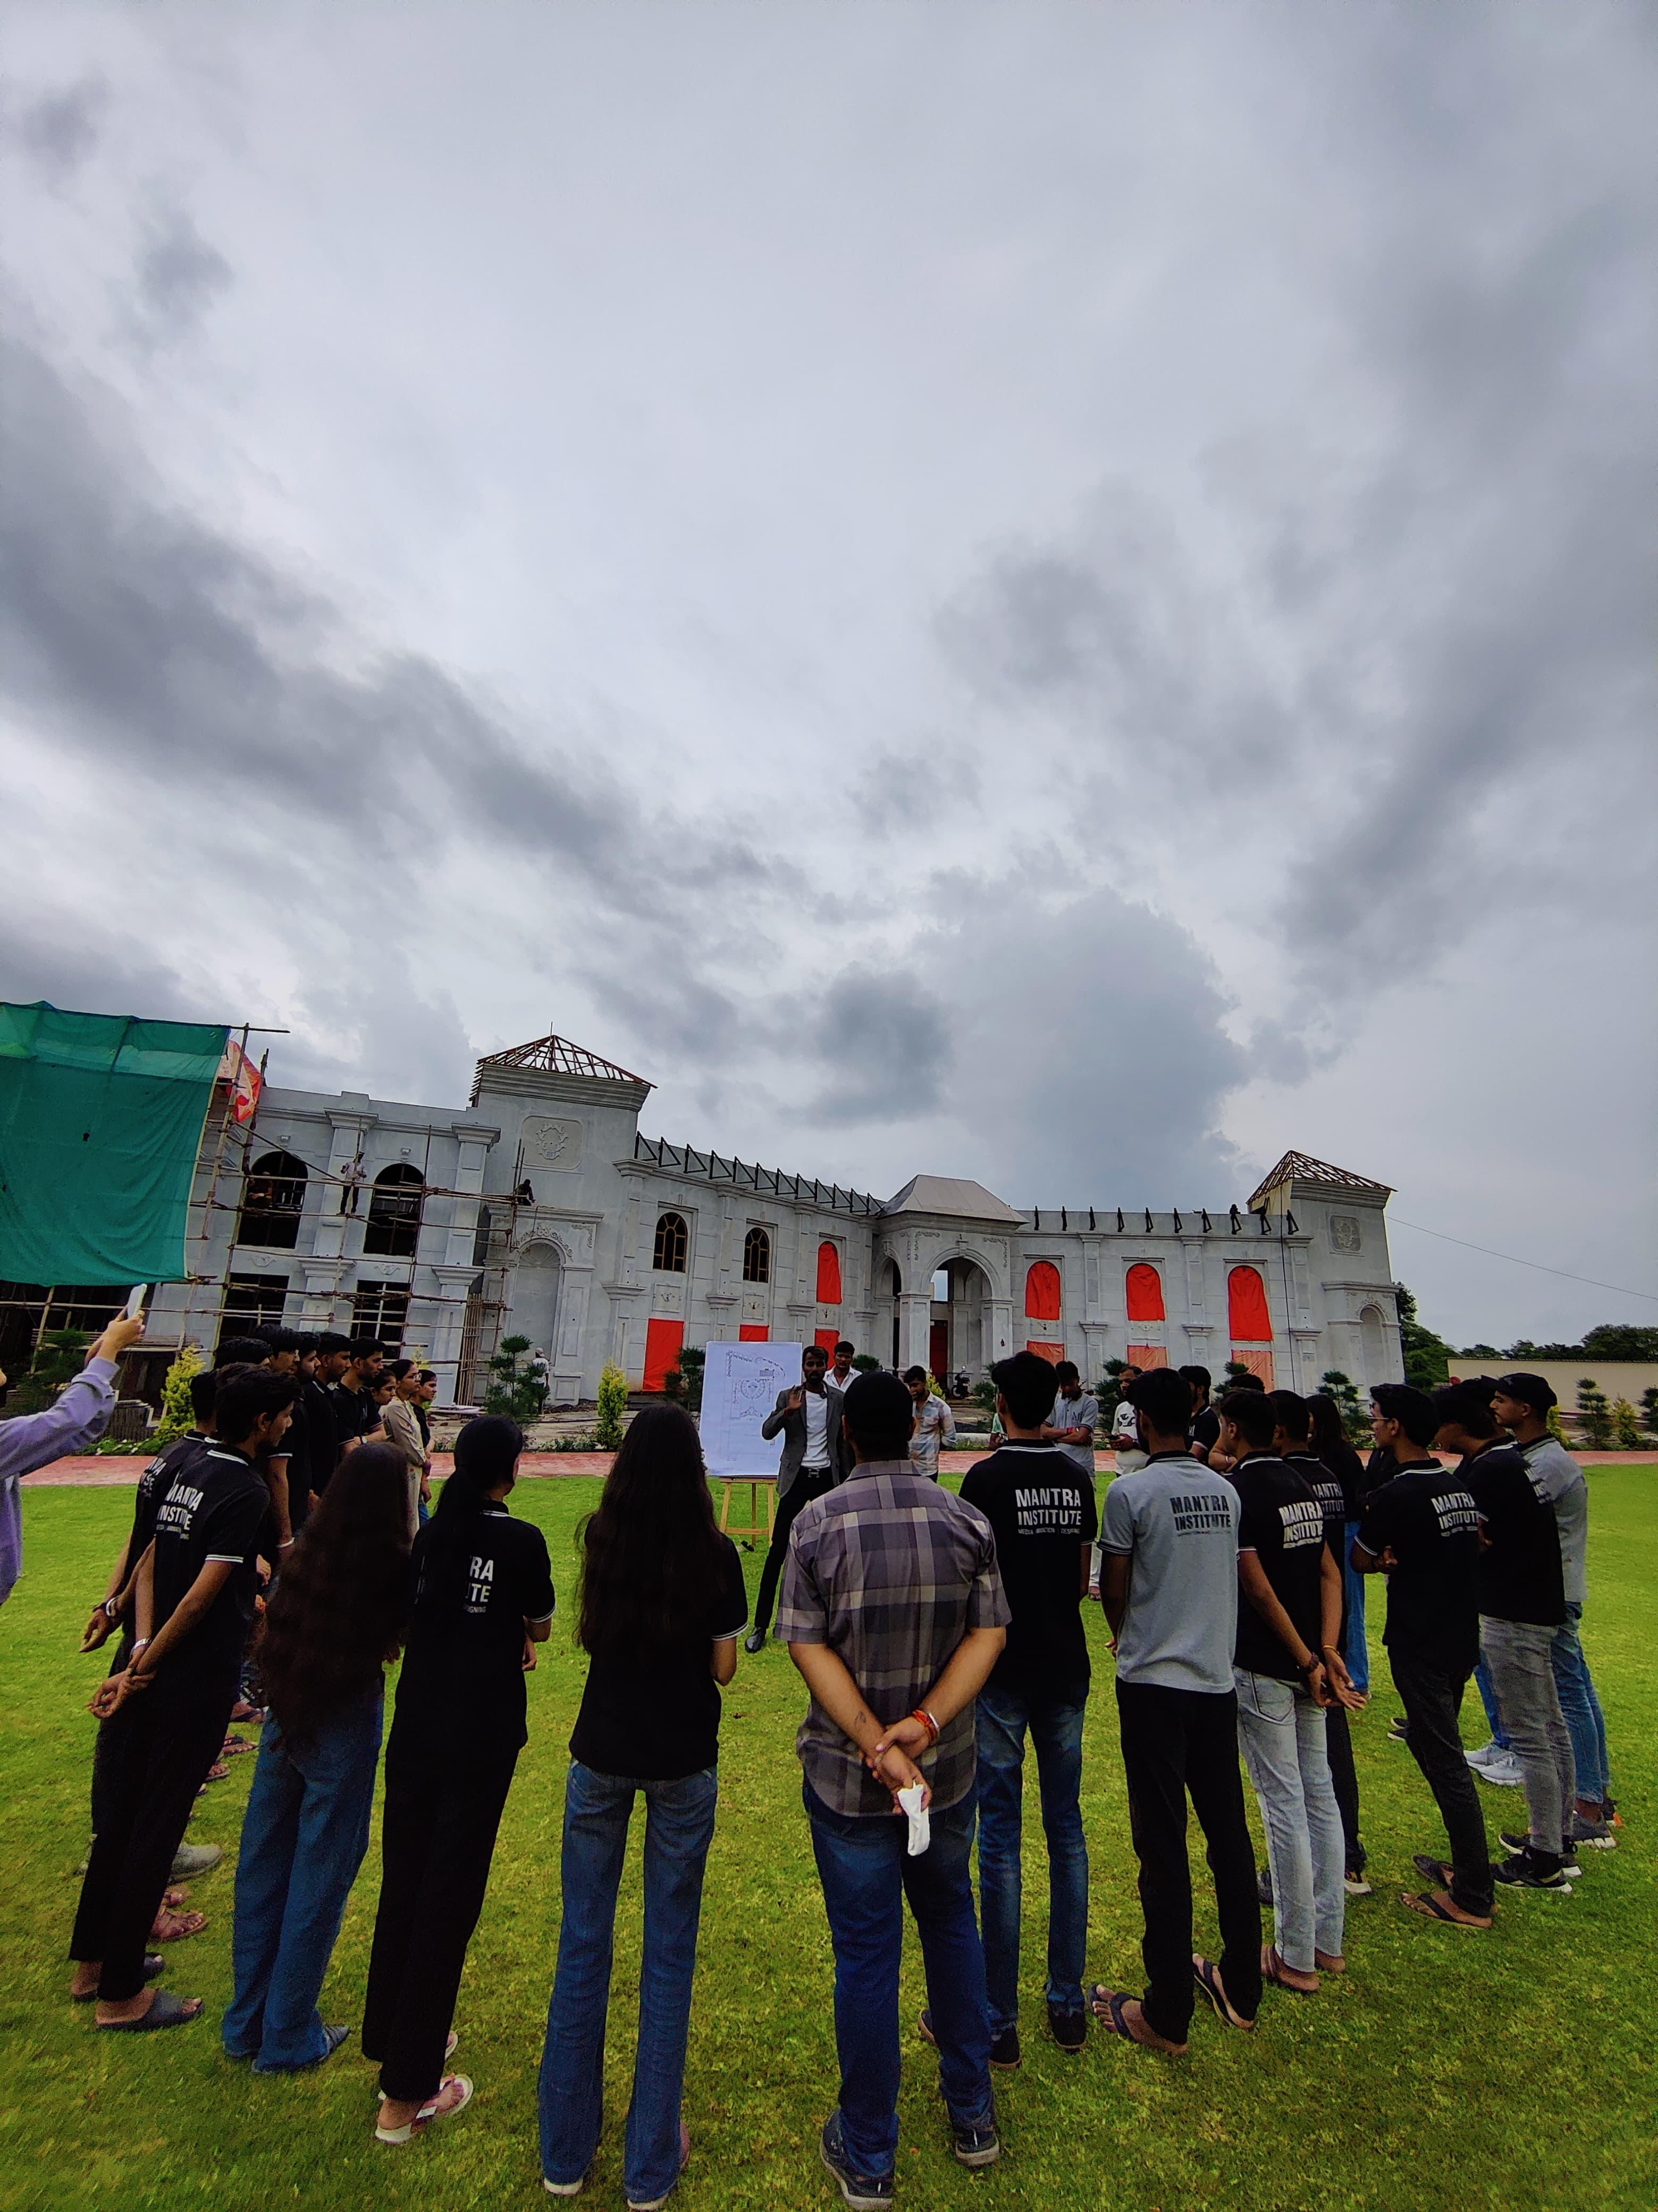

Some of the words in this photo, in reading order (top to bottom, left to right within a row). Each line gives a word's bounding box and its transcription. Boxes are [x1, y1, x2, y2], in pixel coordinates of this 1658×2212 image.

[164, 1475, 204, 1512] MANA
[1015, 1488, 1081, 1507] MANTRA
[1430, 1492, 1476, 1514] MANTRA
[1169, 1495, 1230, 1514] MANTRA
[1278, 1501, 1323, 1526] MANTRA
[1320, 1499, 1345, 1513] TITUT
[1018, 1509, 1082, 1526] INSTITUTE
[1174, 1514, 1231, 1531] INSTITUTE
